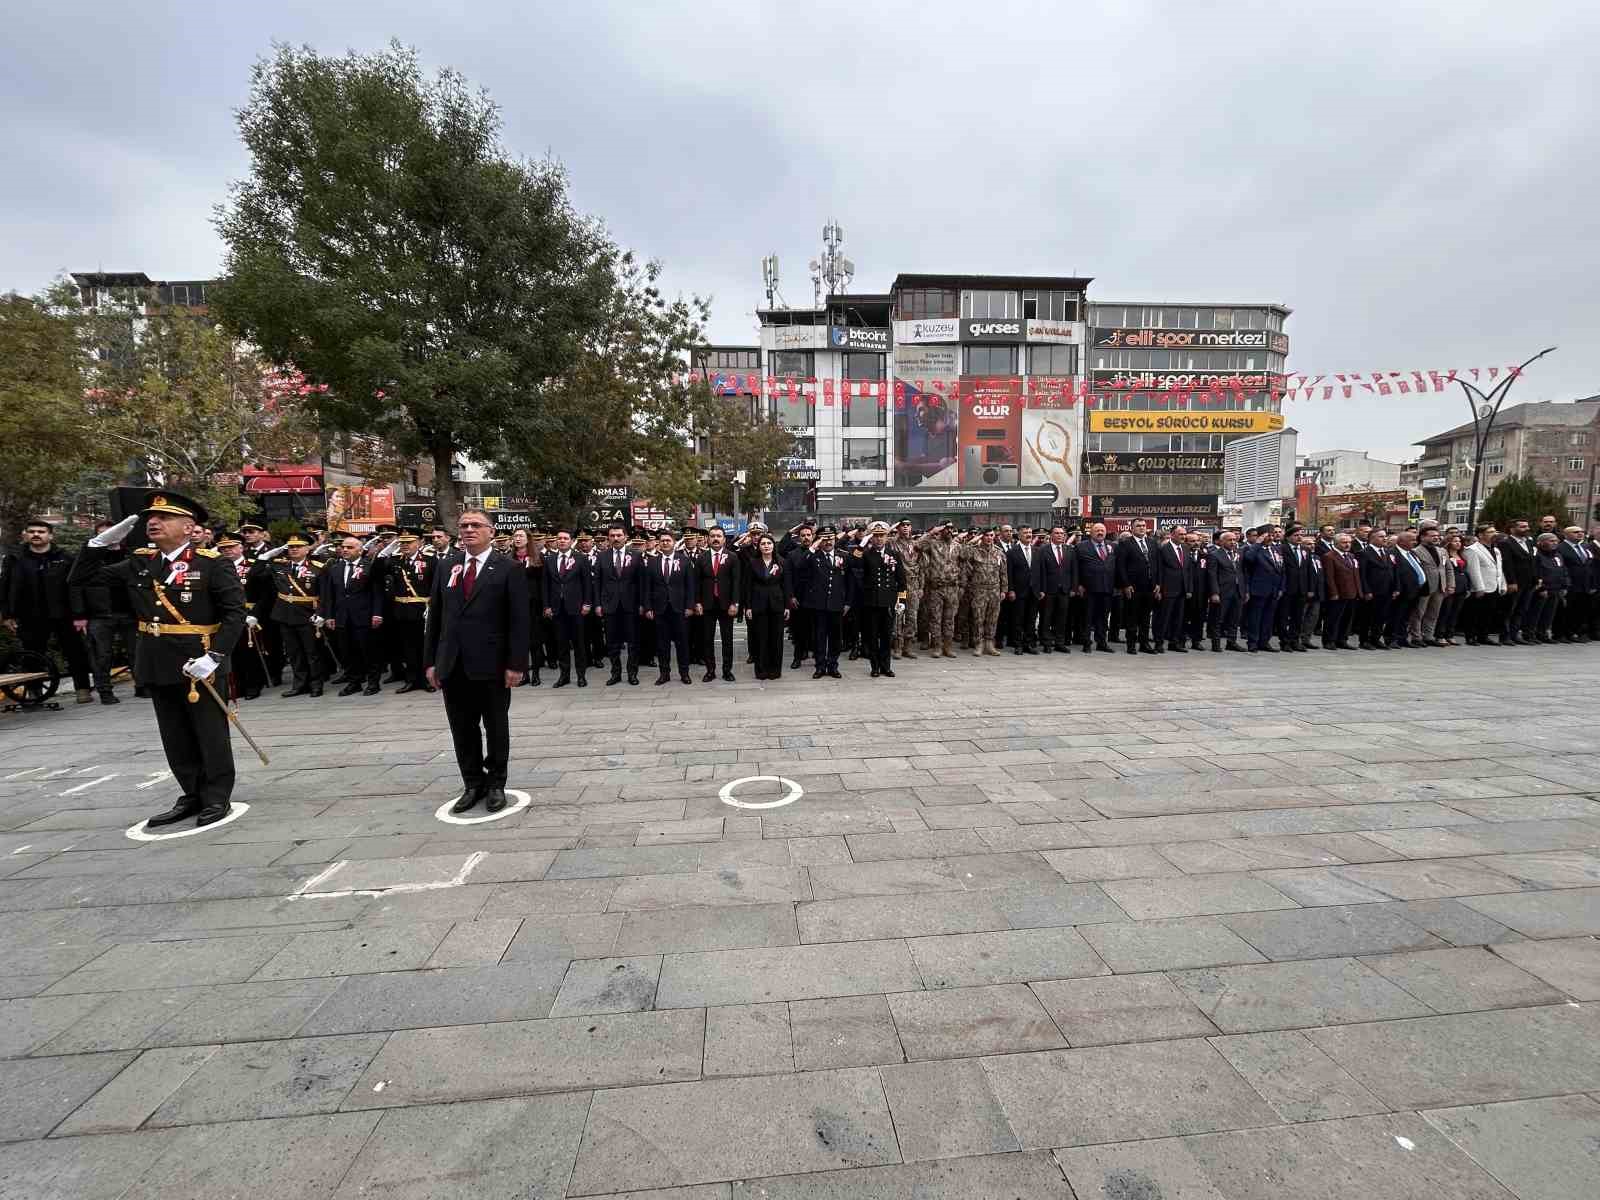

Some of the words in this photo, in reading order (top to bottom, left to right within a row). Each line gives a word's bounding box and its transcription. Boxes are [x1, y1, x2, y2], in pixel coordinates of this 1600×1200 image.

[849, 328, 888, 342] btpoint
[1156, 332, 1195, 348] spor
[1199, 330, 1267, 345] merkezi
[973, 404, 1010, 416] OLUR
[1103, 417, 1153, 429] BEŞYOL
[1156, 415, 1209, 428] SÜRÜCÜ
[1212, 417, 1254, 428] KURSU
[1137, 457, 1166, 471] GOLD
[591, 487, 628, 497] ARMASİ
[498, 514, 530, 523] Bizden
